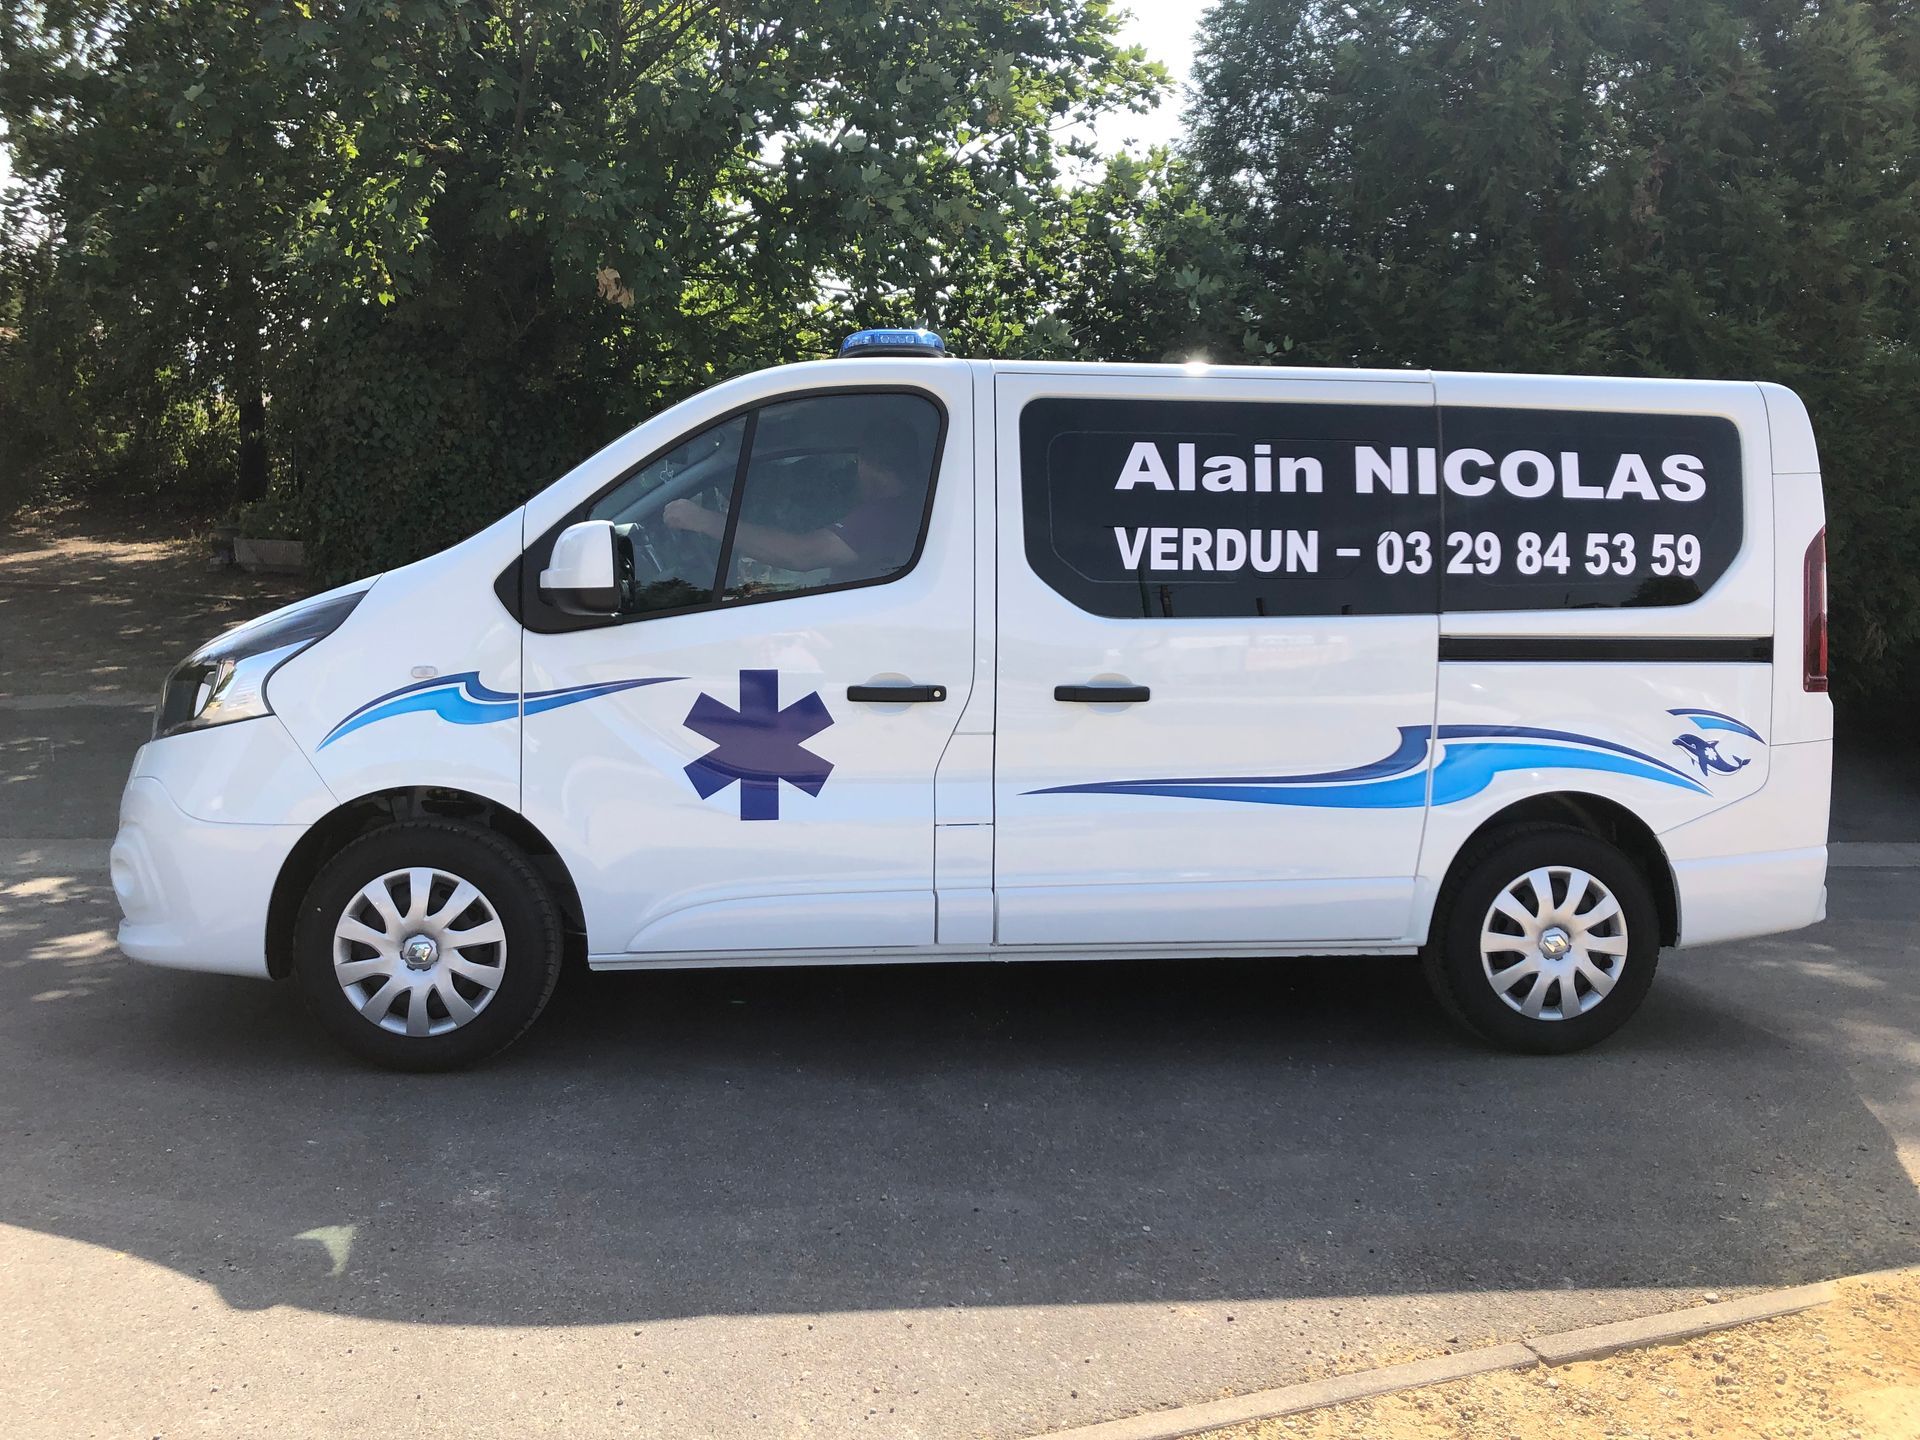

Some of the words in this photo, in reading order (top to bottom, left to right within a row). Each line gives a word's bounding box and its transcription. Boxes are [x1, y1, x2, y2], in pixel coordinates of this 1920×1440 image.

[1115, 442, 1323, 492] Alain
[1355, 446, 1707, 501] NICOLAS
[1114, 527, 1319, 573] VERDUN
[1377, 531, 1433, 575] 03
[1447, 532, 1502, 575] 29
[1517, 532, 1571, 575] 84
[1585, 533, 1637, 576] 53
[1651, 534, 1701, 577] 59
